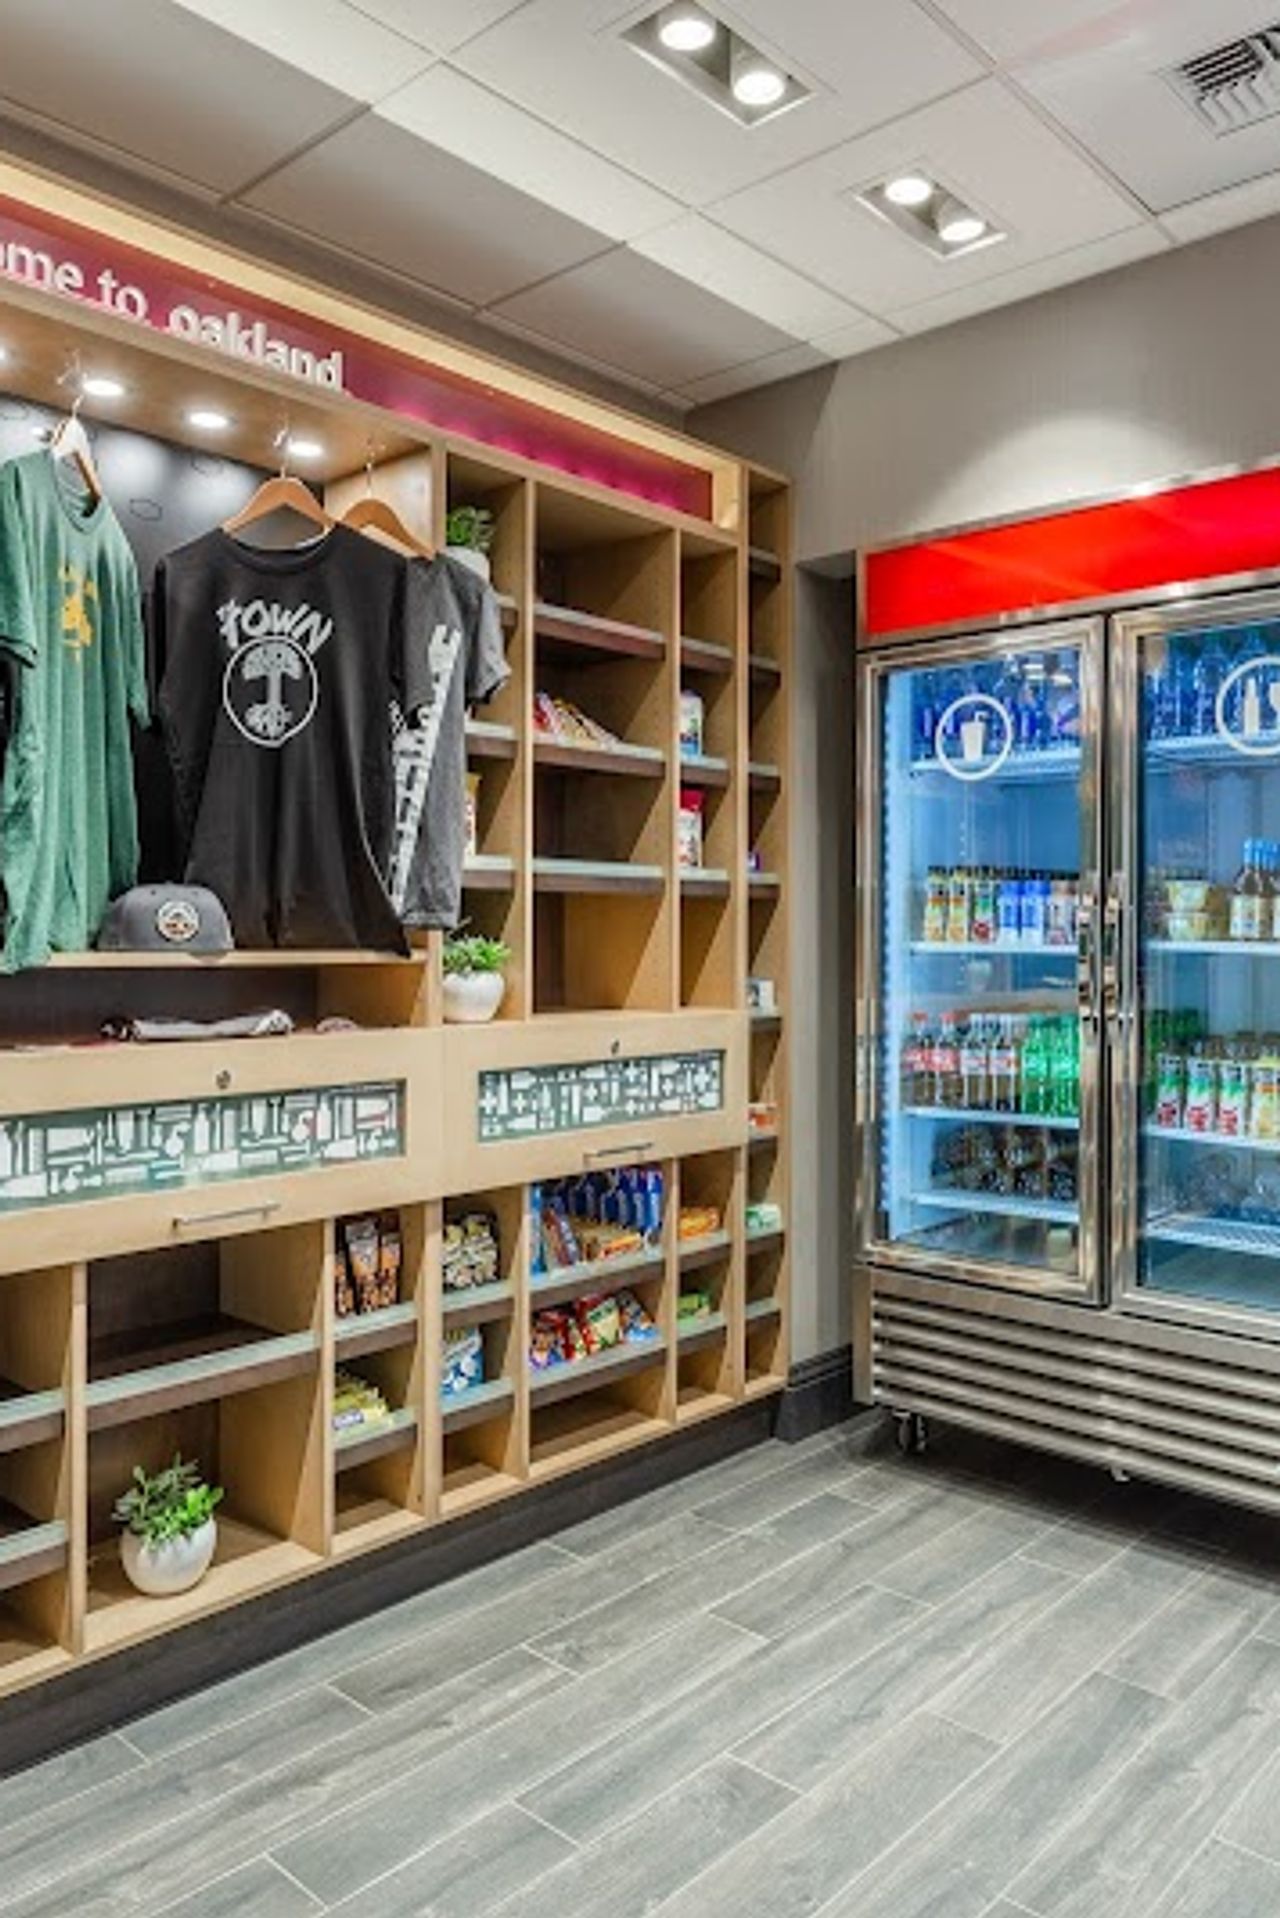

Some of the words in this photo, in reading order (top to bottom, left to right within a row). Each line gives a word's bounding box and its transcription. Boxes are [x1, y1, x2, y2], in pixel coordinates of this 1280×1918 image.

[0, 242, 84, 297] me
[97, 269, 148, 322] to
[169, 304, 343, 392] oakland
[216, 597, 333, 655] TOWN
